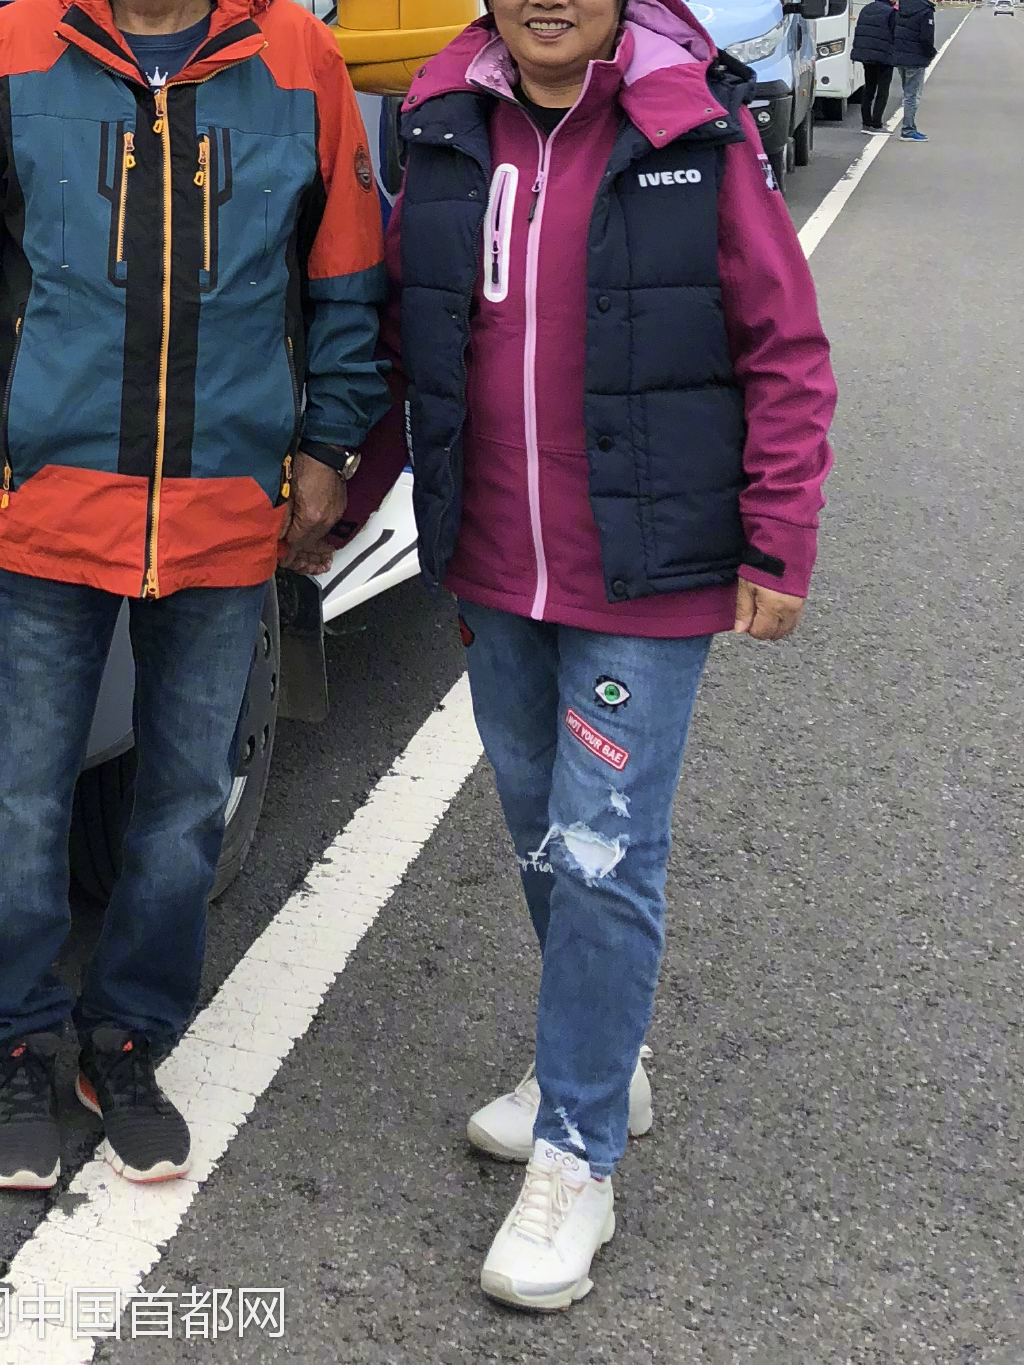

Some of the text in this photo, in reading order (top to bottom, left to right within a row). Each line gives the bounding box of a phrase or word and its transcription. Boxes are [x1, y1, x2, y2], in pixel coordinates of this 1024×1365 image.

[638, 169, 701, 187] IVECO
[568, 716, 623, 763] NOT YOUR BAE
